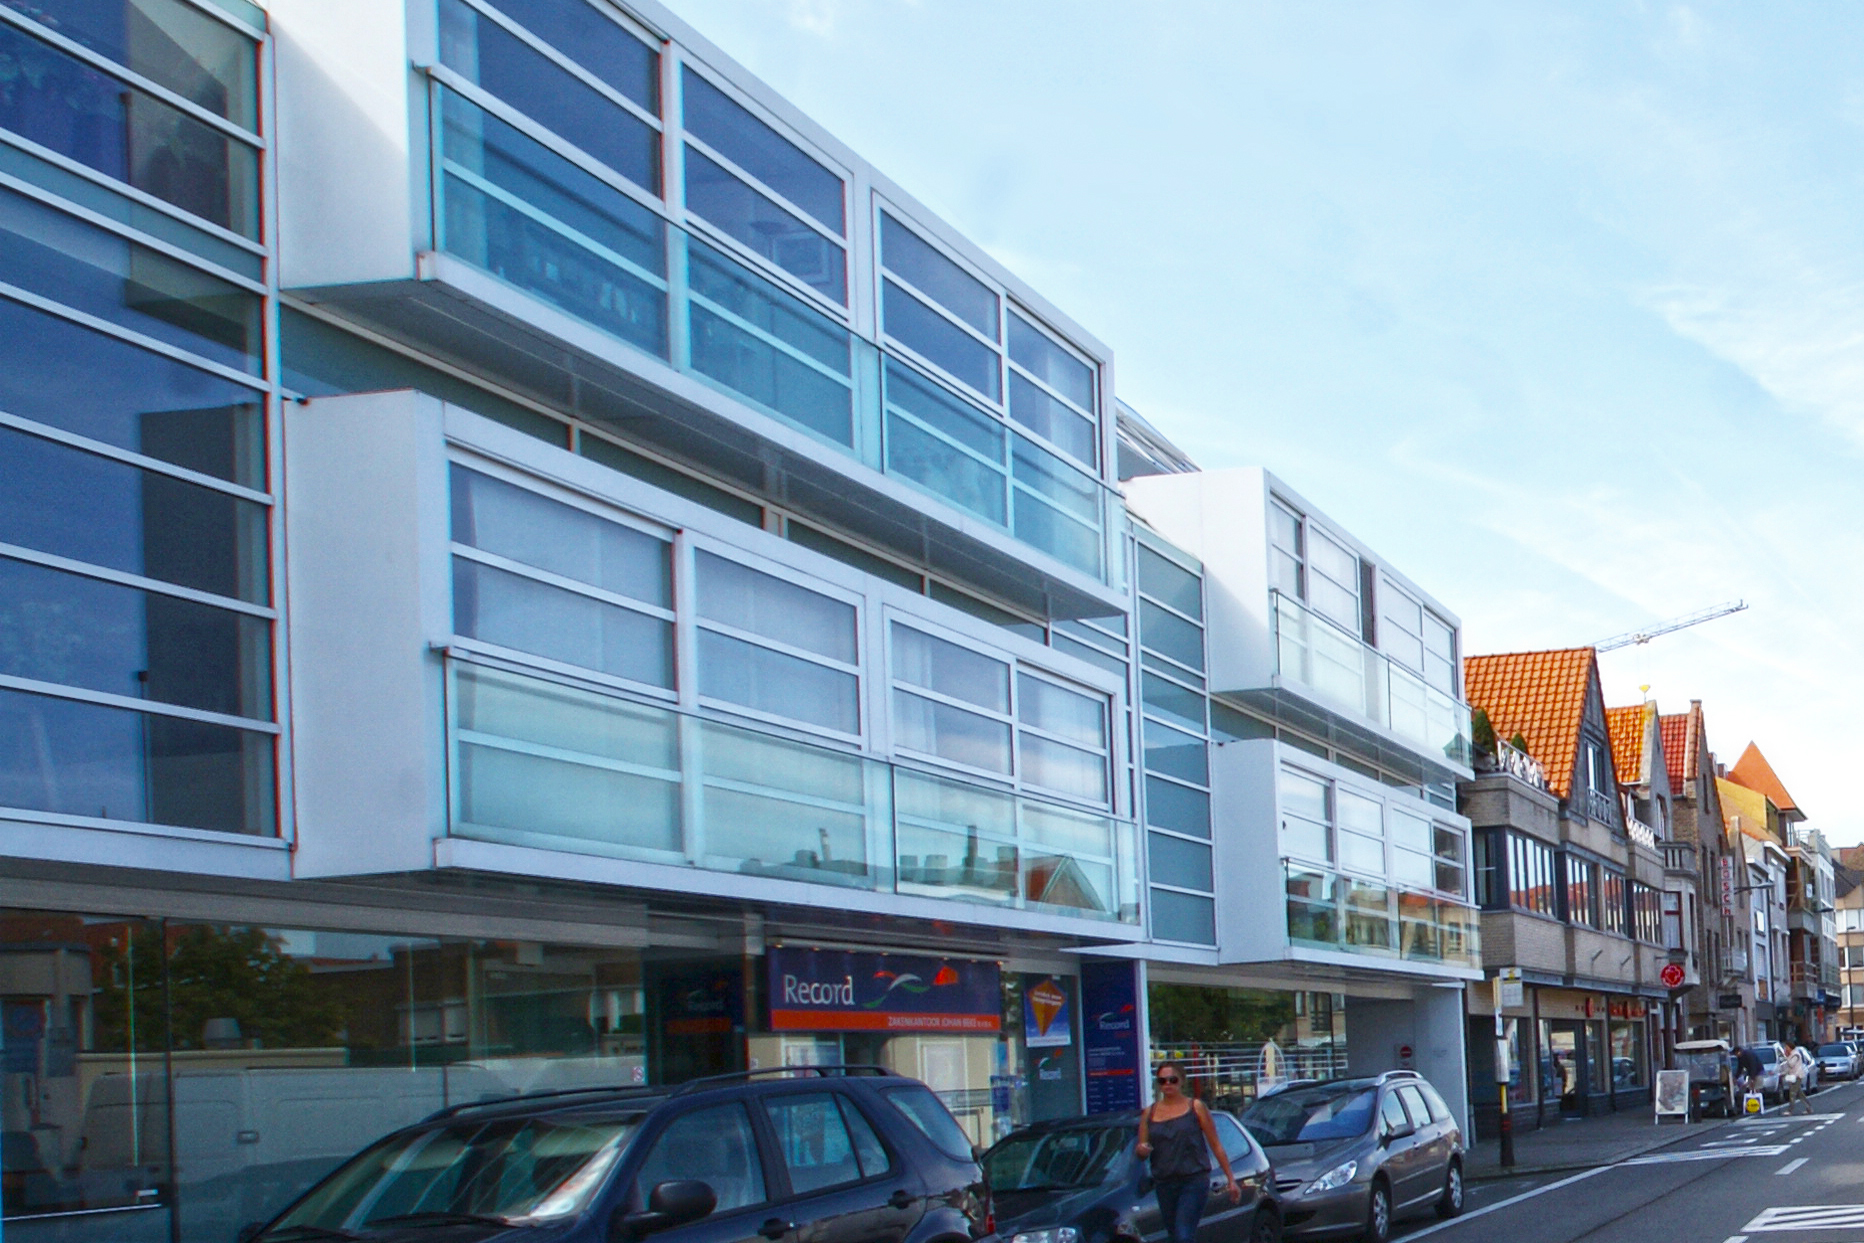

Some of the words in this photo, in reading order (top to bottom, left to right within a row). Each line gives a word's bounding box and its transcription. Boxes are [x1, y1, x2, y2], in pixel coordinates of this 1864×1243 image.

[783, 974, 856, 1006] Record
[888, 1016, 940, 1027] ZAKENKANTOOR
[1099, 1018, 1130, 1030] Record
